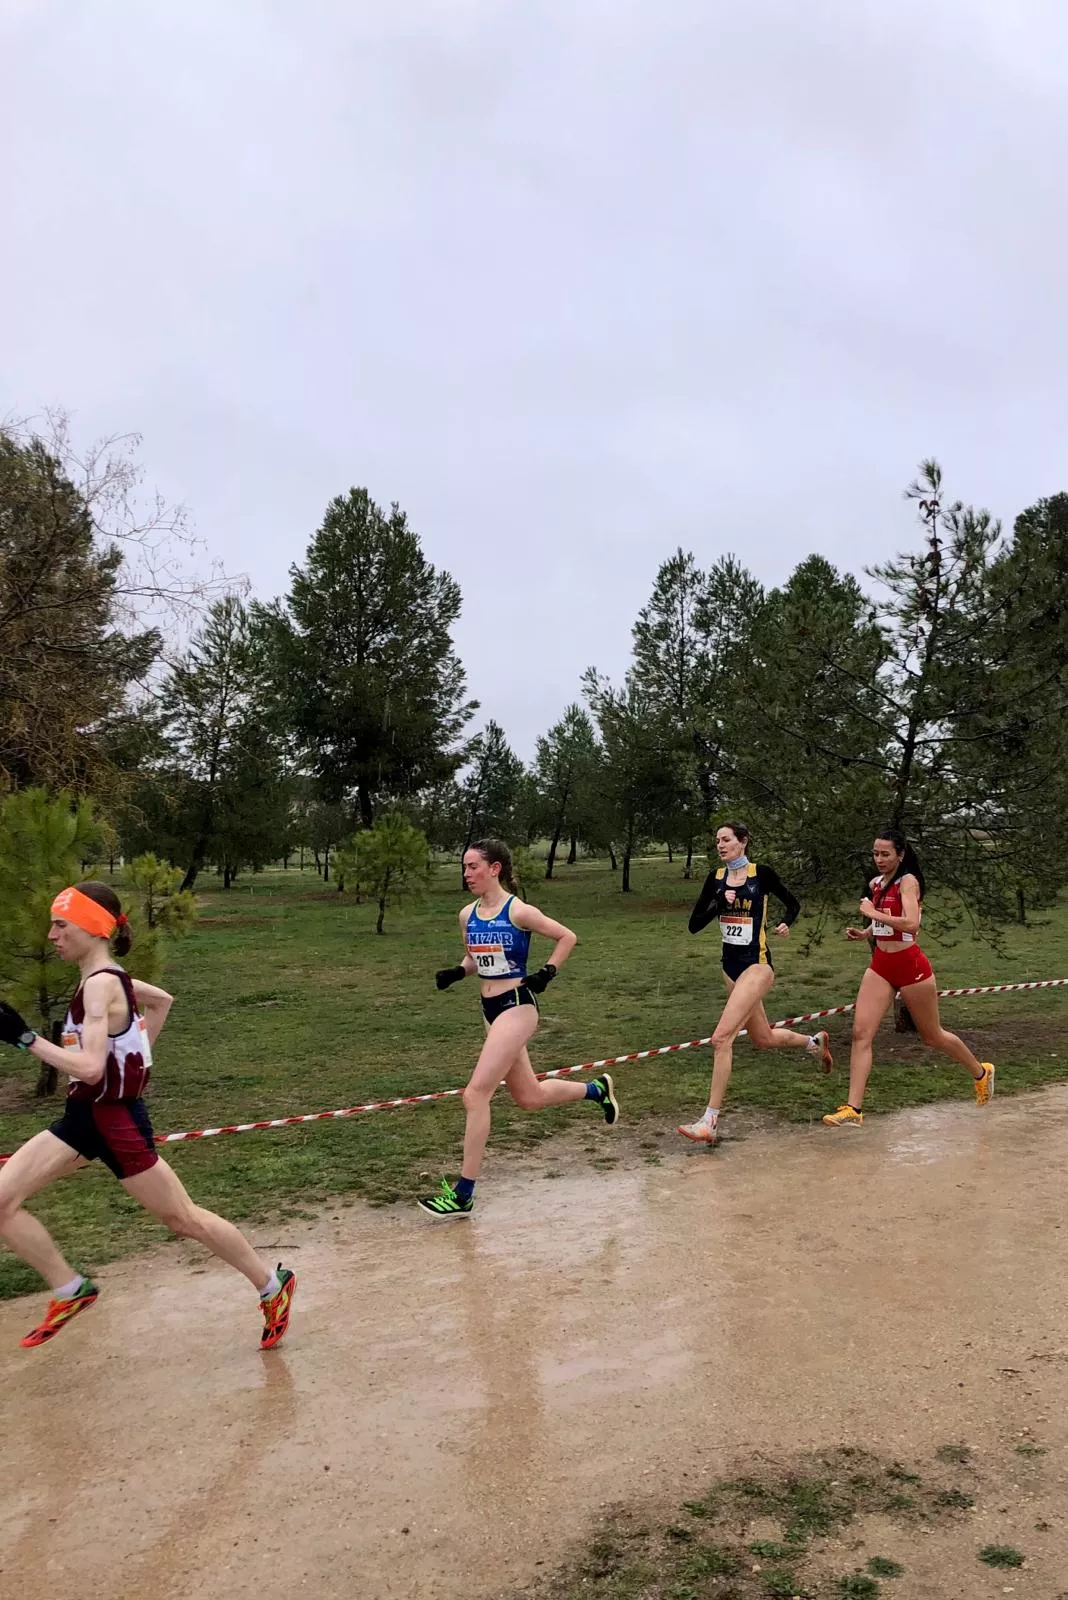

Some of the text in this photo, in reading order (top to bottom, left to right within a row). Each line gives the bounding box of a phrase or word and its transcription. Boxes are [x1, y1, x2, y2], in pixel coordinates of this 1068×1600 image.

[726, 925, 742, 936] 222
[467, 931, 513, 945] NIZAR
[476, 955, 494, 967] 287
